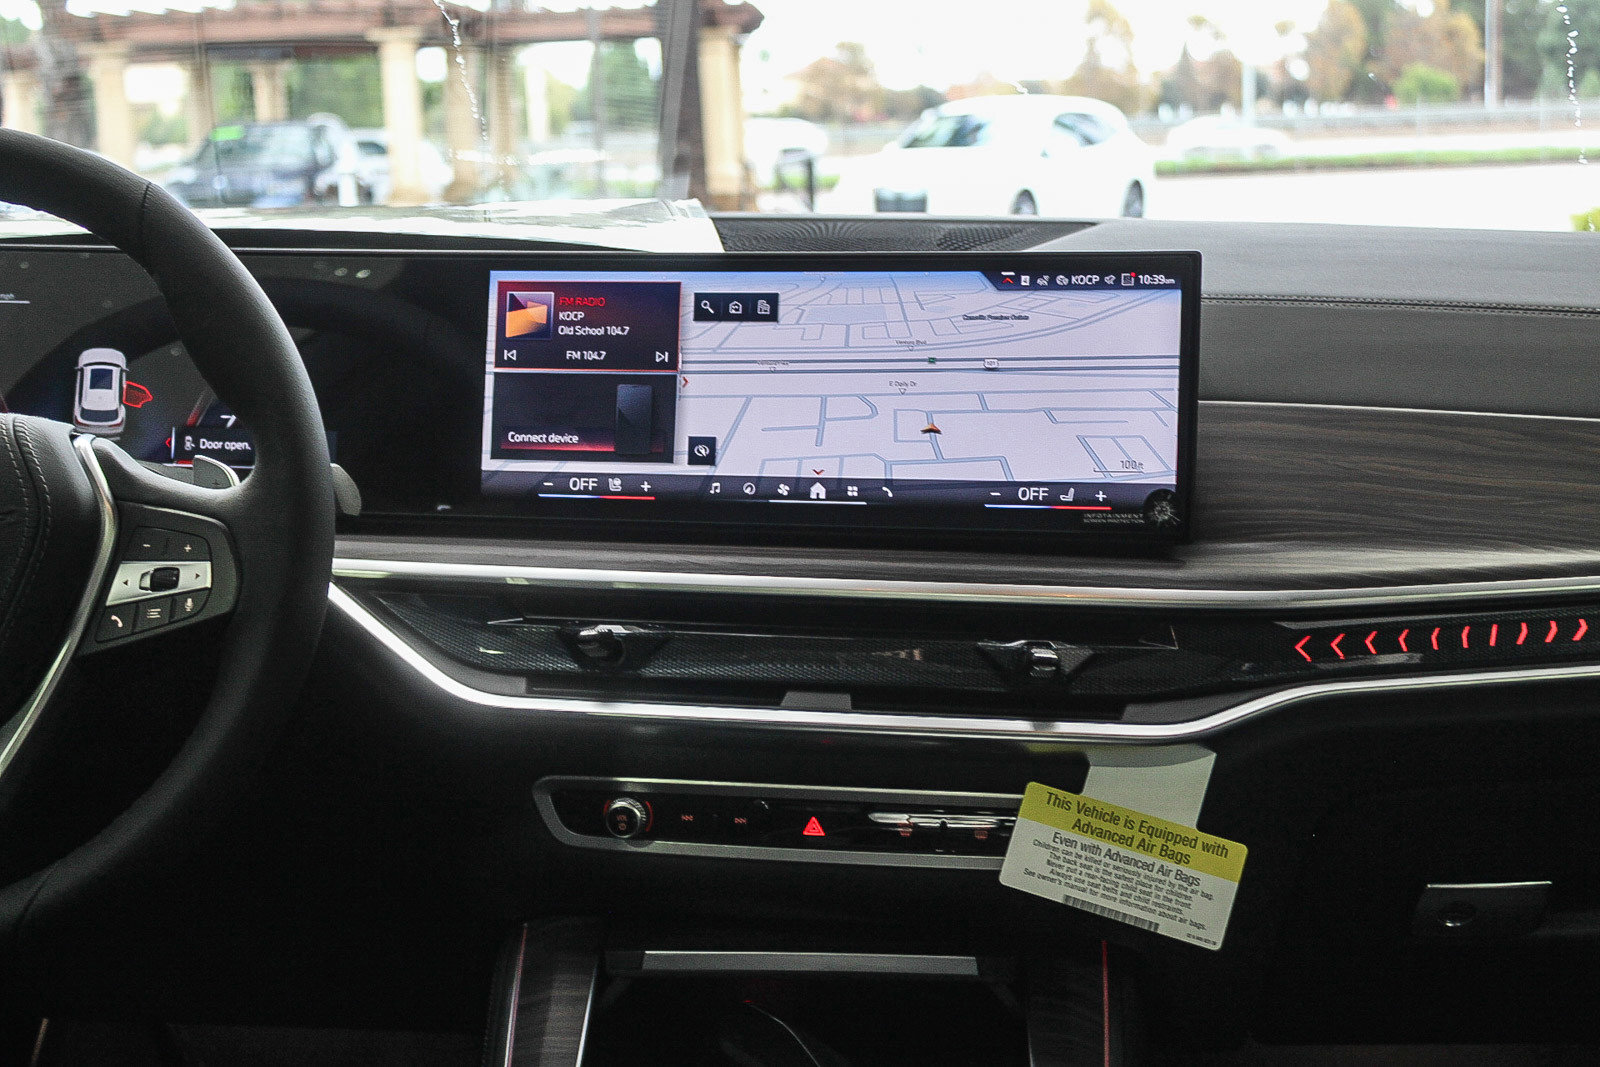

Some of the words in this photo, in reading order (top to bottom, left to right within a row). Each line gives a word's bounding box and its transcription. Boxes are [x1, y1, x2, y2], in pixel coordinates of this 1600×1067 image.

[1071, 274, 1100, 285] KOCP
[559, 297, 574, 306] FM
[576, 297, 606, 307] RADIO
[558, 325, 574, 335] Old
[575, 325, 605, 335] School
[606, 326, 630, 336] 104.7
[566, 350, 580, 360] FM
[582, 350, 607, 360] 104.7
[199, 438, 223, 450] Door
[224, 441, 252, 451] open.
[508, 431, 547, 443] Connect
[548, 432, 579, 443] device
[569, 477, 598, 491] OFF
[1018, 487, 1049, 501] OFF
[1045, 791, 1072, 811] This
[1075, 800, 1121, 825] Vehicle
[1123, 815, 1135, 830] is
[1137, 819, 1198, 849] Equipped
[1201, 840, 1228, 858] with
[1071, 817, 1134, 847] Advanced
[1136, 837, 1156, 853] Air
[1158, 843, 1191, 865] Bags
[1032, 838, 1059, 852] Children
[1084, 855, 1102, 865] killed
[1111, 864, 1140, 878] seriously
[1143, 873, 1166, 885] injured
[1167, 880, 1177, 889] by
[1177, 883, 1189, 892] the
[1189, 887, 1199, 895] air
[1200, 890, 1214, 900] bag.
[1052, 831, 1078, 848] Even
[1079, 841, 1102, 856] with
[1103, 847, 1155, 872] Advanced
[1155, 863, 1173, 877] Air
[1173, 868, 1201, 887] Bags
[1046, 858, 1065, 869] Never
[1065, 866, 1077, 874] put
[1121, 883, 1137, 892] child
[1138, 888, 1152, 897] seat
[1162, 895, 1173, 903] the
[1174, 898, 1192, 909] front.
[1049, 851, 1061, 861] The
[1062, 856, 1077, 866] back
[1079, 862, 1093, 870] seat
[1101, 868, 1112, 876] the
[1113, 872, 1134, 883] safest
[1134, 879, 1152, 889] place
[1153, 884, 1163, 892] for
[1165, 888, 1193, 901] children.
[1049, 868, 1072, 880] Always
[1073, 876, 1085, 884] use
[1086, 880, 1101, 889] seat
[1101, 884, 1118, 895] belts
[1119, 890, 1132, 899] and
[1133, 895, 1150, 904] child
[1151, 900, 1183, 914] restraints.
[1023, 867, 1036, 877] See
[1036, 873, 1062, 885] owner's
[1063, 881, 1087, 893] manual
[1088, 888, 1098, 896] for
[1100, 892, 1117, 902] more
[1118, 898, 1157, 915] information
[1158, 910, 1177, 921] about
[1188, 918, 1207, 930] bags.
